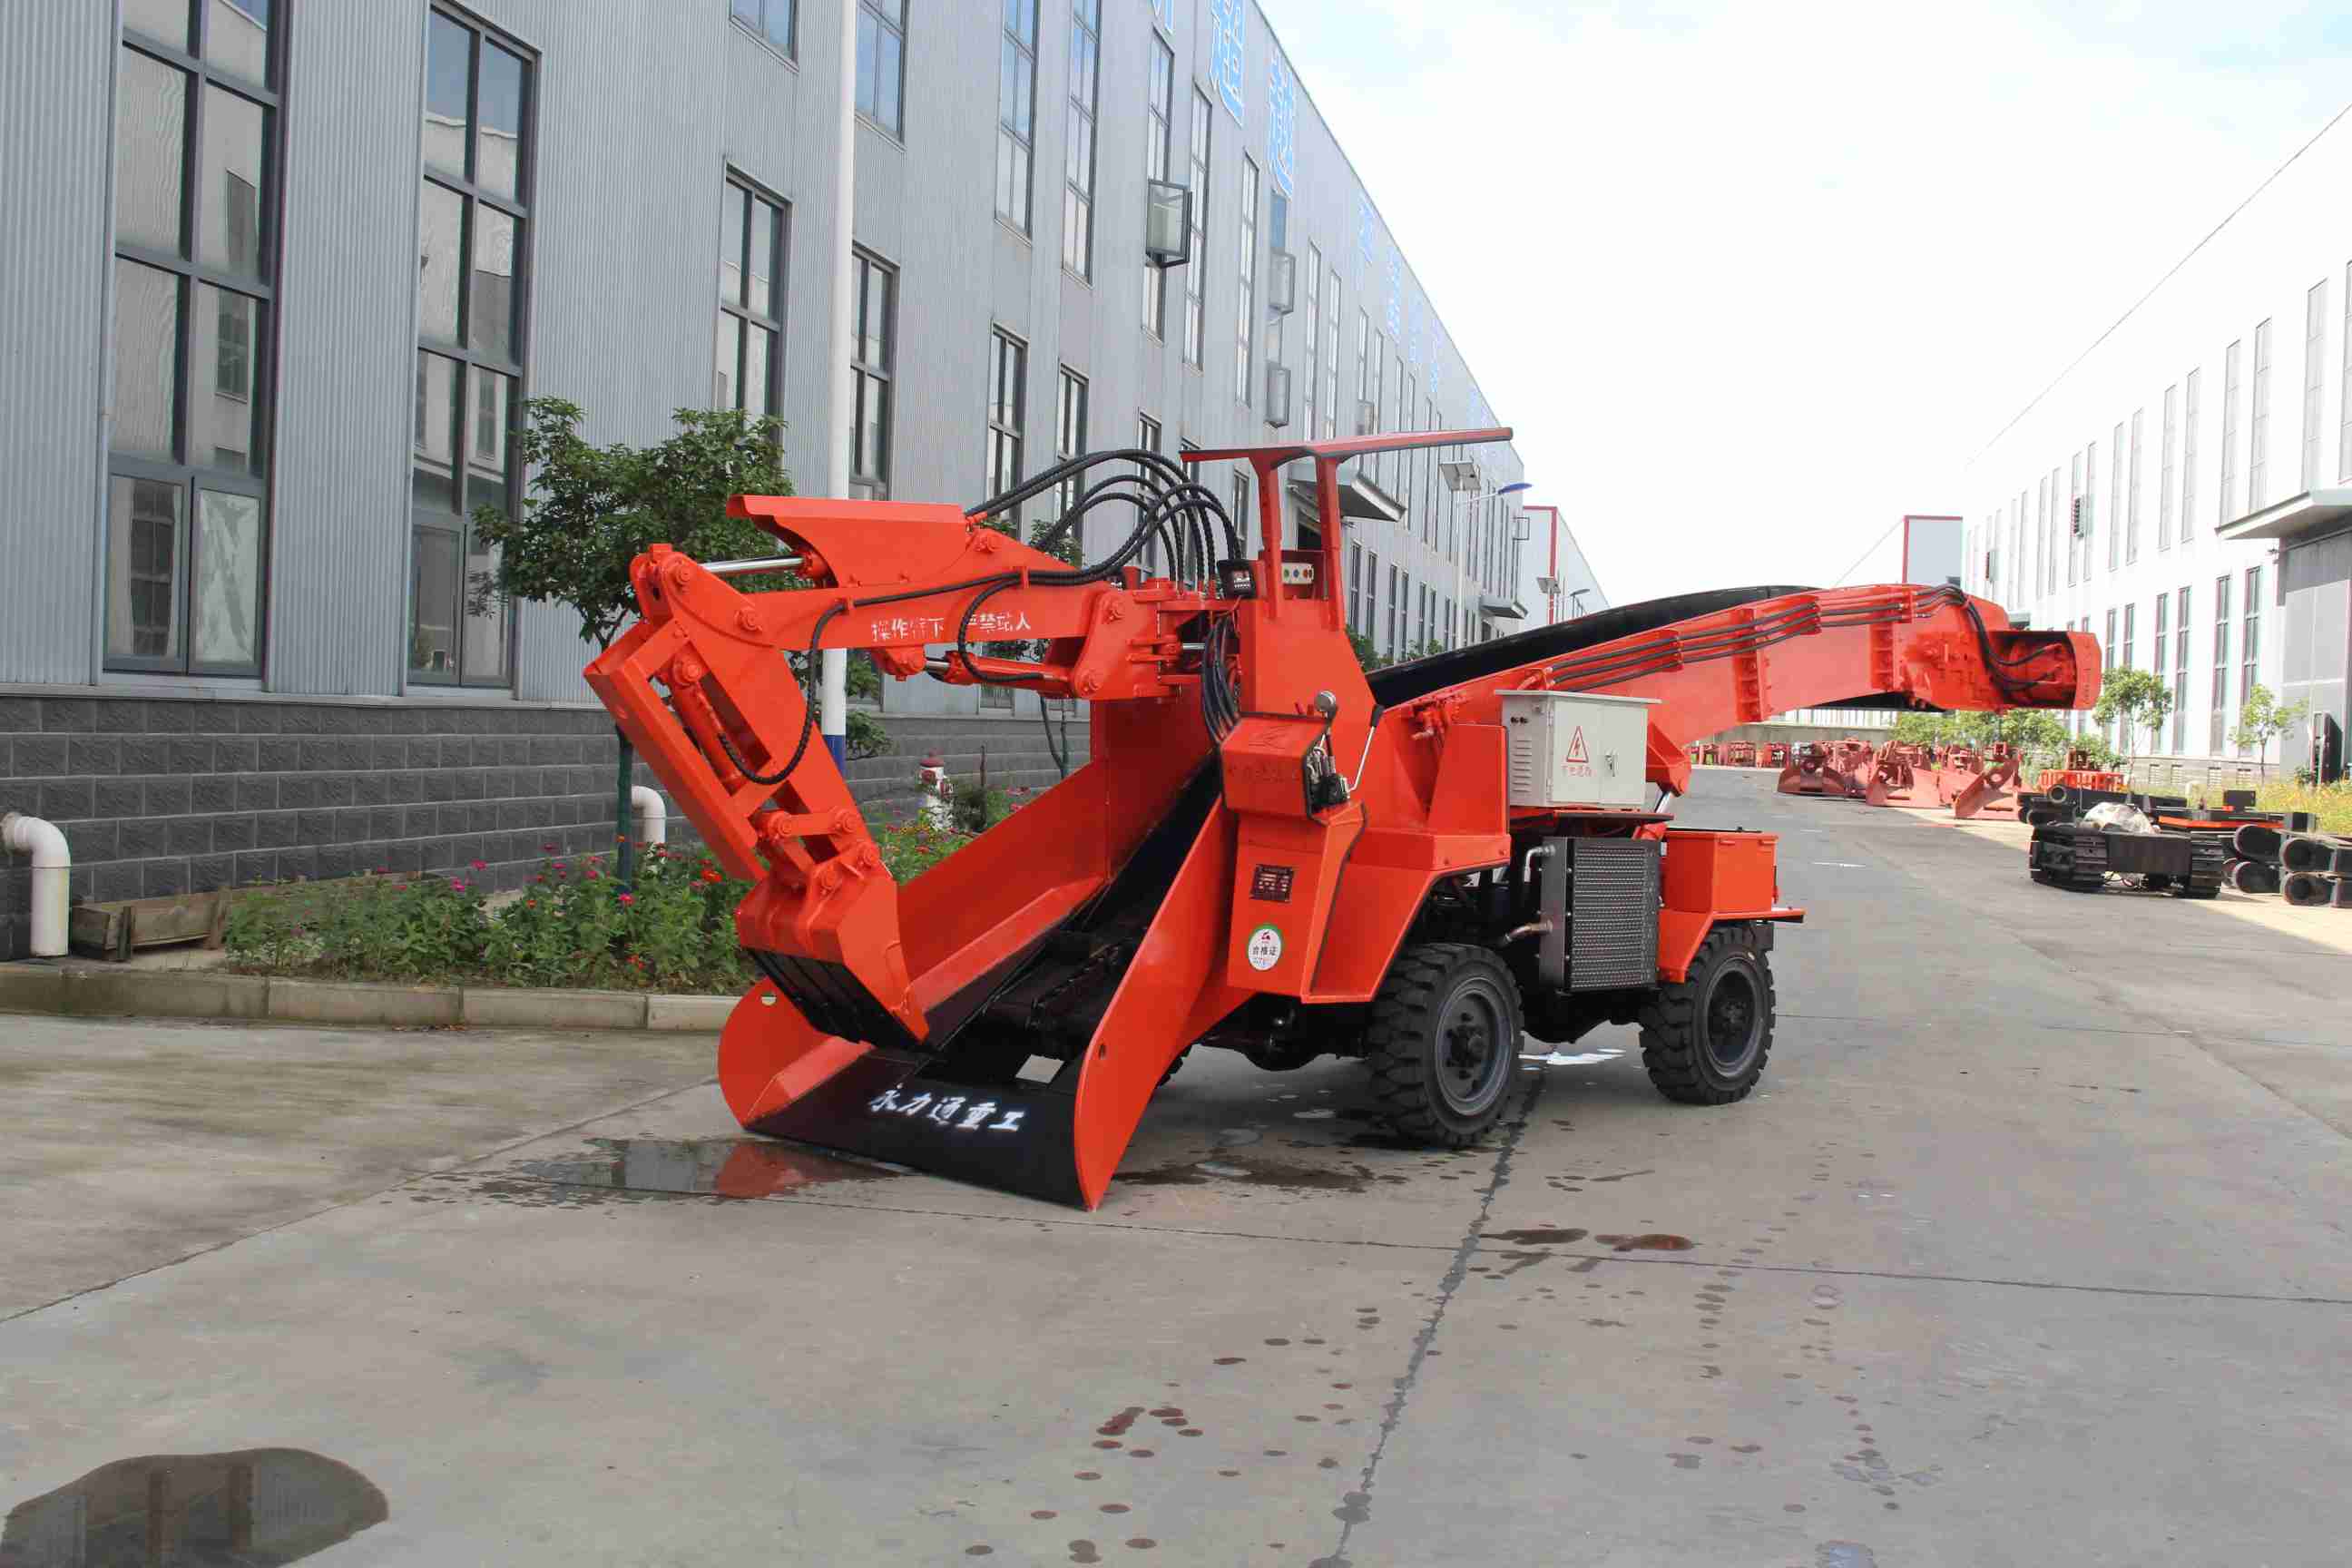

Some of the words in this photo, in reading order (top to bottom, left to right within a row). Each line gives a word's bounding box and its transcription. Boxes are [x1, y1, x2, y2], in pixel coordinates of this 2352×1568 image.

[867, 1082, 1026, 1132] 永力通重工
